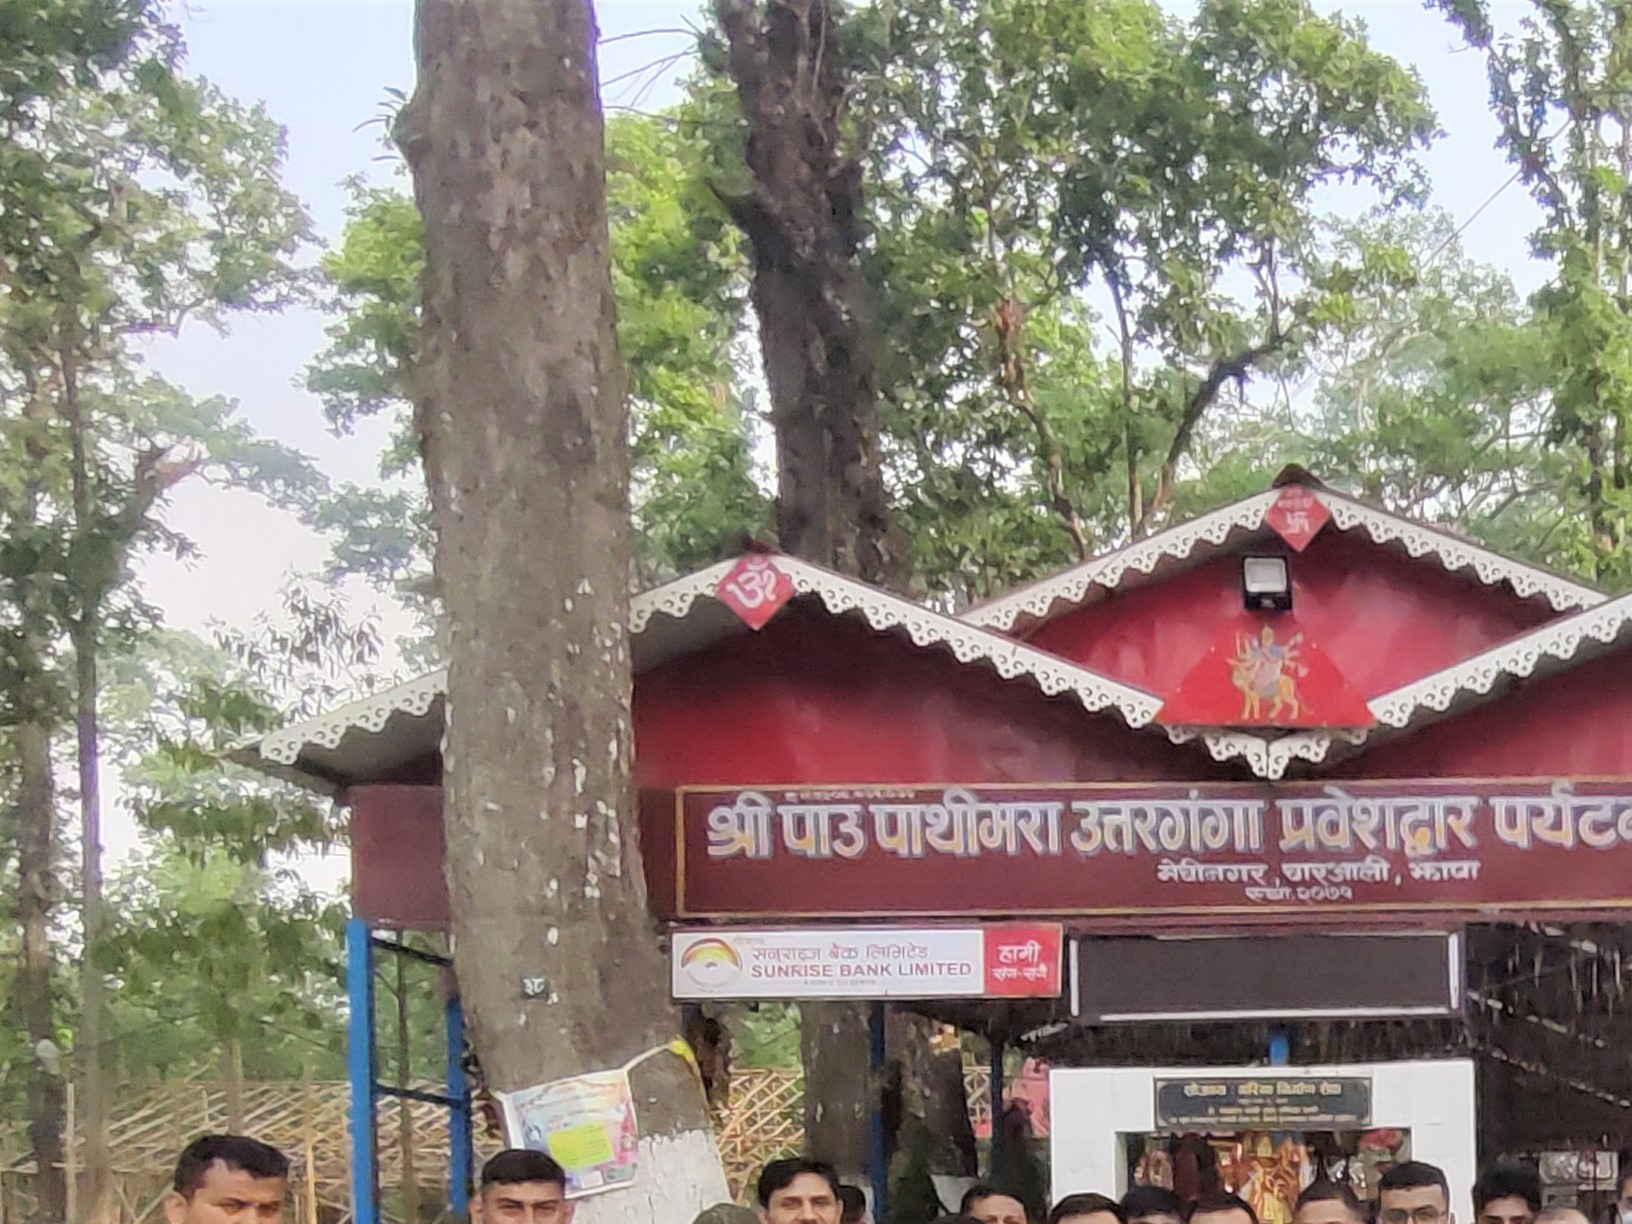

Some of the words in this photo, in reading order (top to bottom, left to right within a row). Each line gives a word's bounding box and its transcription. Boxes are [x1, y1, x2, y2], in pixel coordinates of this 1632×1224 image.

[706, 790, 772, 858] श्री
[776, 804, 864, 858] पाउ
[1069, 788, 1265, 855] उत्तरगंगा
[1275, 785, 1480, 857] प्रवेशद्वार
[750, 963, 835, 979] SUNRISE
[840, 963, 892, 978] BANK
[897, 961, 973, 977] LIMITED
